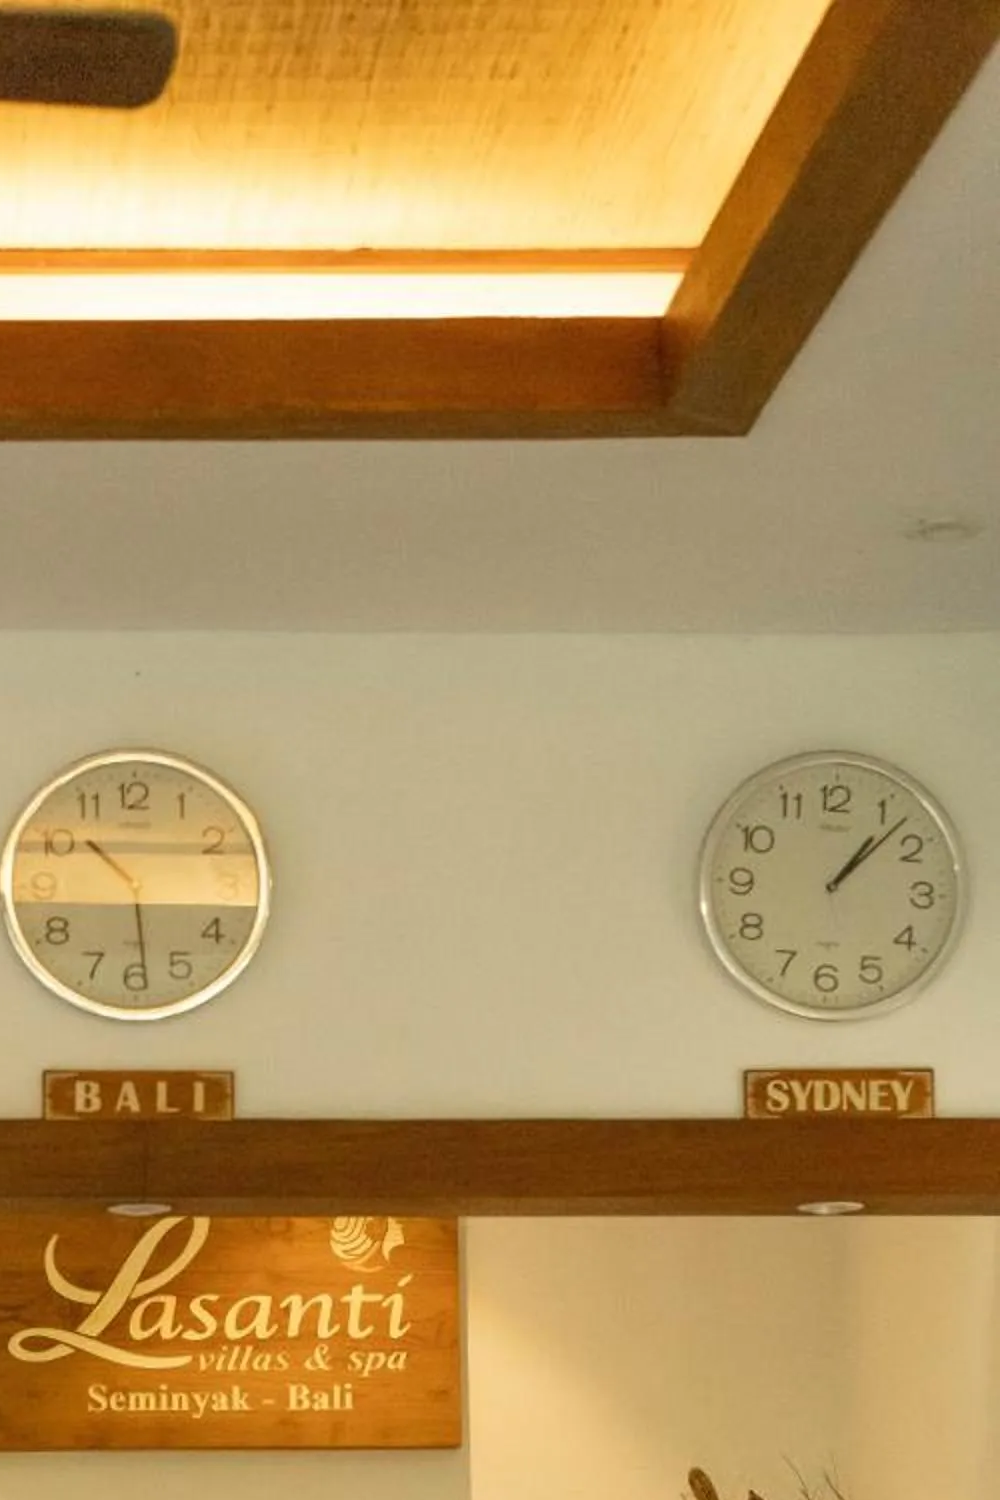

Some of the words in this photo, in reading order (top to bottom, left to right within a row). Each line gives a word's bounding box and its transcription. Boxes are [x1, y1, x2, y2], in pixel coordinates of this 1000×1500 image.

[78, 792, 100, 820] 11
[118, 781, 150, 810] 12
[176, 792, 185, 819] 1
[780, 792, 803, 820] 11
[820, 784, 852, 813] 12
[877, 799, 886, 825] 1
[41, 828, 75, 857] 10
[201, 826, 225, 855] 2
[740, 825, 775, 854] 10
[899, 834, 924, 863] 2
[30, 871, 56, 900] 9
[729, 867, 755, 896] 9
[909, 881, 935, 909] 3
[45, 916, 70, 945] 8
[200, 917, 225, 944] 4
[739, 913, 764, 940] 8
[893, 925, 917, 950] 4
[82, 952, 105, 980] 7
[123, 963, 148, 991] 6
[168, 952, 193, 980] 5
[775, 949, 797, 977] 7
[858, 955, 883, 984] 5
[813, 964, 839, 993] 6
[74, 1080, 206, 1113] BALI
[766, 1079, 914, 1112] SYDNEY
[7, 1215, 413, 1369] Lasanti
[199, 1345, 290, 1371] villas
[304, 1343, 332, 1371] &
[347, 1351, 408, 1377] spa
[87, 1383, 253, 1419] Seminyak
[287, 1383, 354, 1412] Bali
